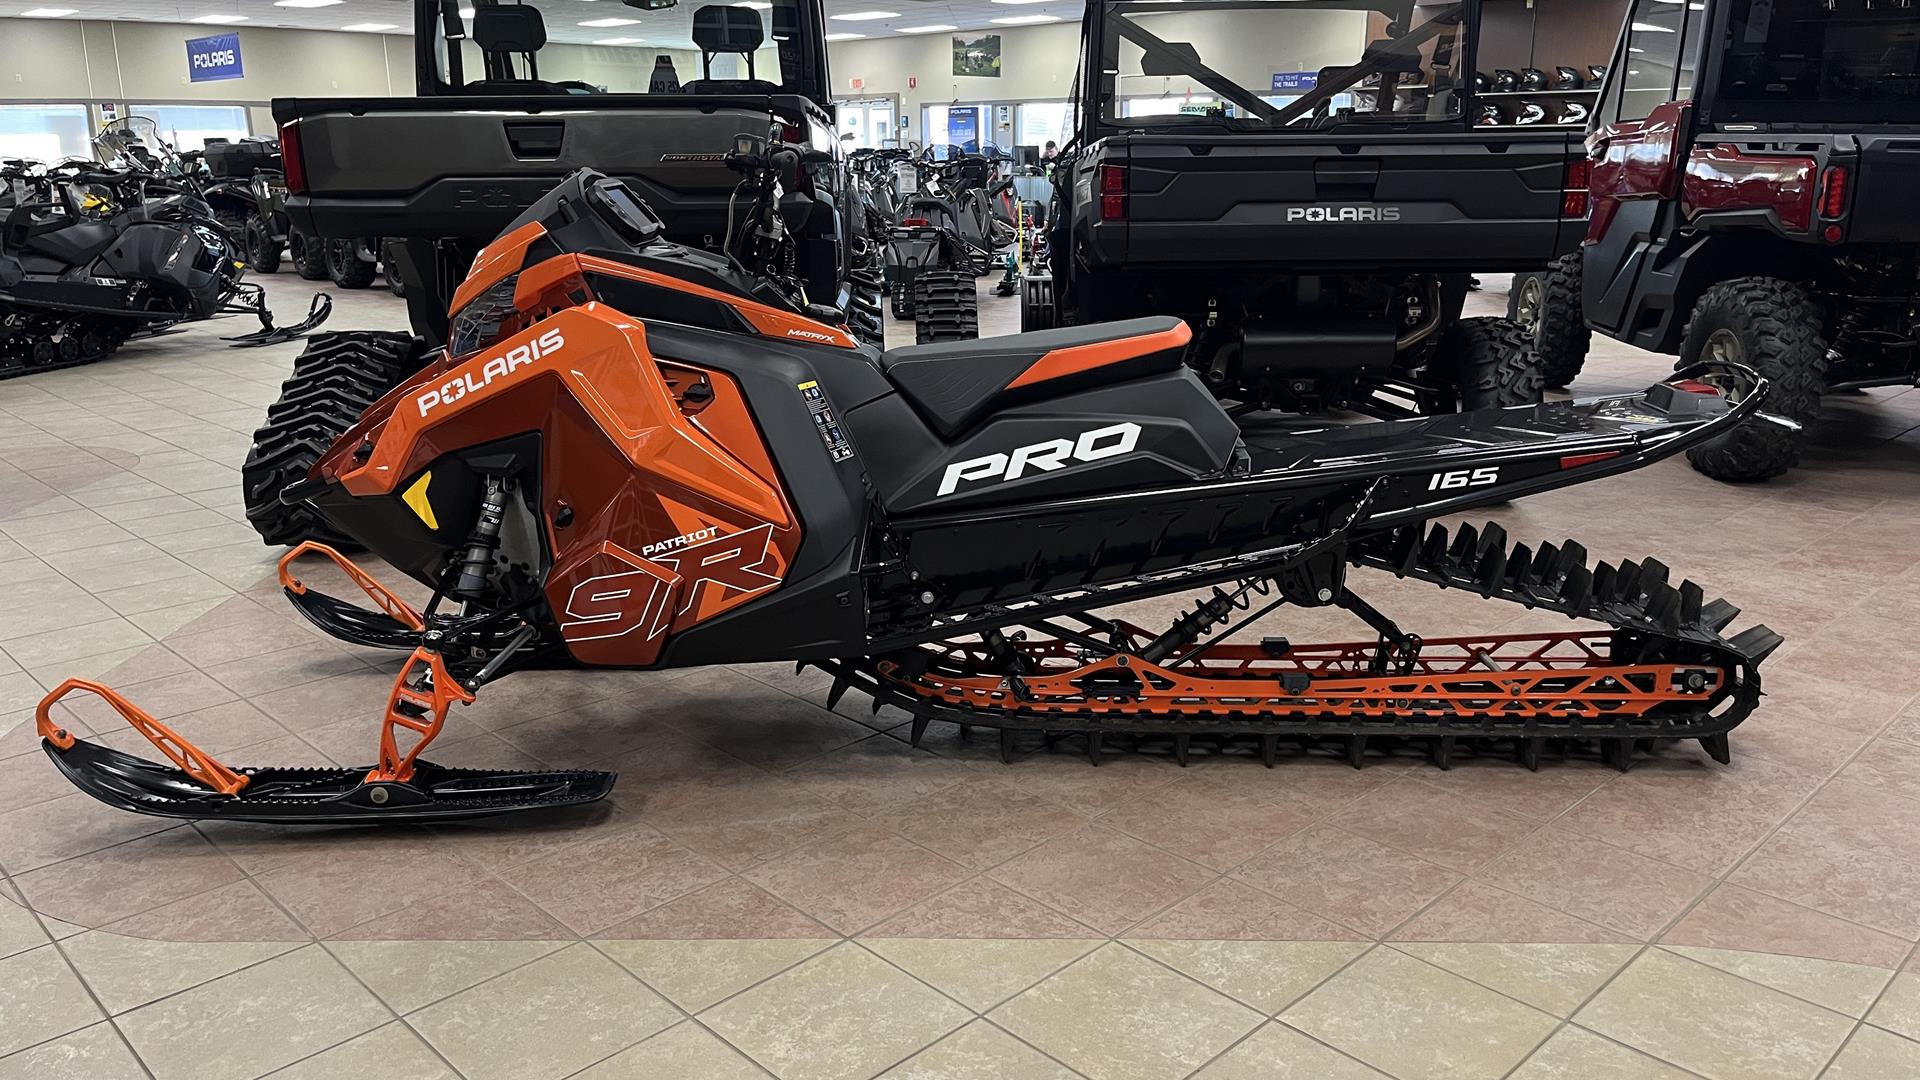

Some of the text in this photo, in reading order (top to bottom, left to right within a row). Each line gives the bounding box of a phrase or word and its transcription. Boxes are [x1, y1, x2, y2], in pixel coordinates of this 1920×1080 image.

[193, 49, 235, 69] POLARIS
[1286, 207, 1401, 222] POLARIS
[787, 329, 835, 344] MATRYX
[416, 327, 565, 418] POLARIS
[936, 422, 1143, 497] PRO
[1427, 466, 1500, 491] 165
[642, 526, 719, 556] PATRIOT
